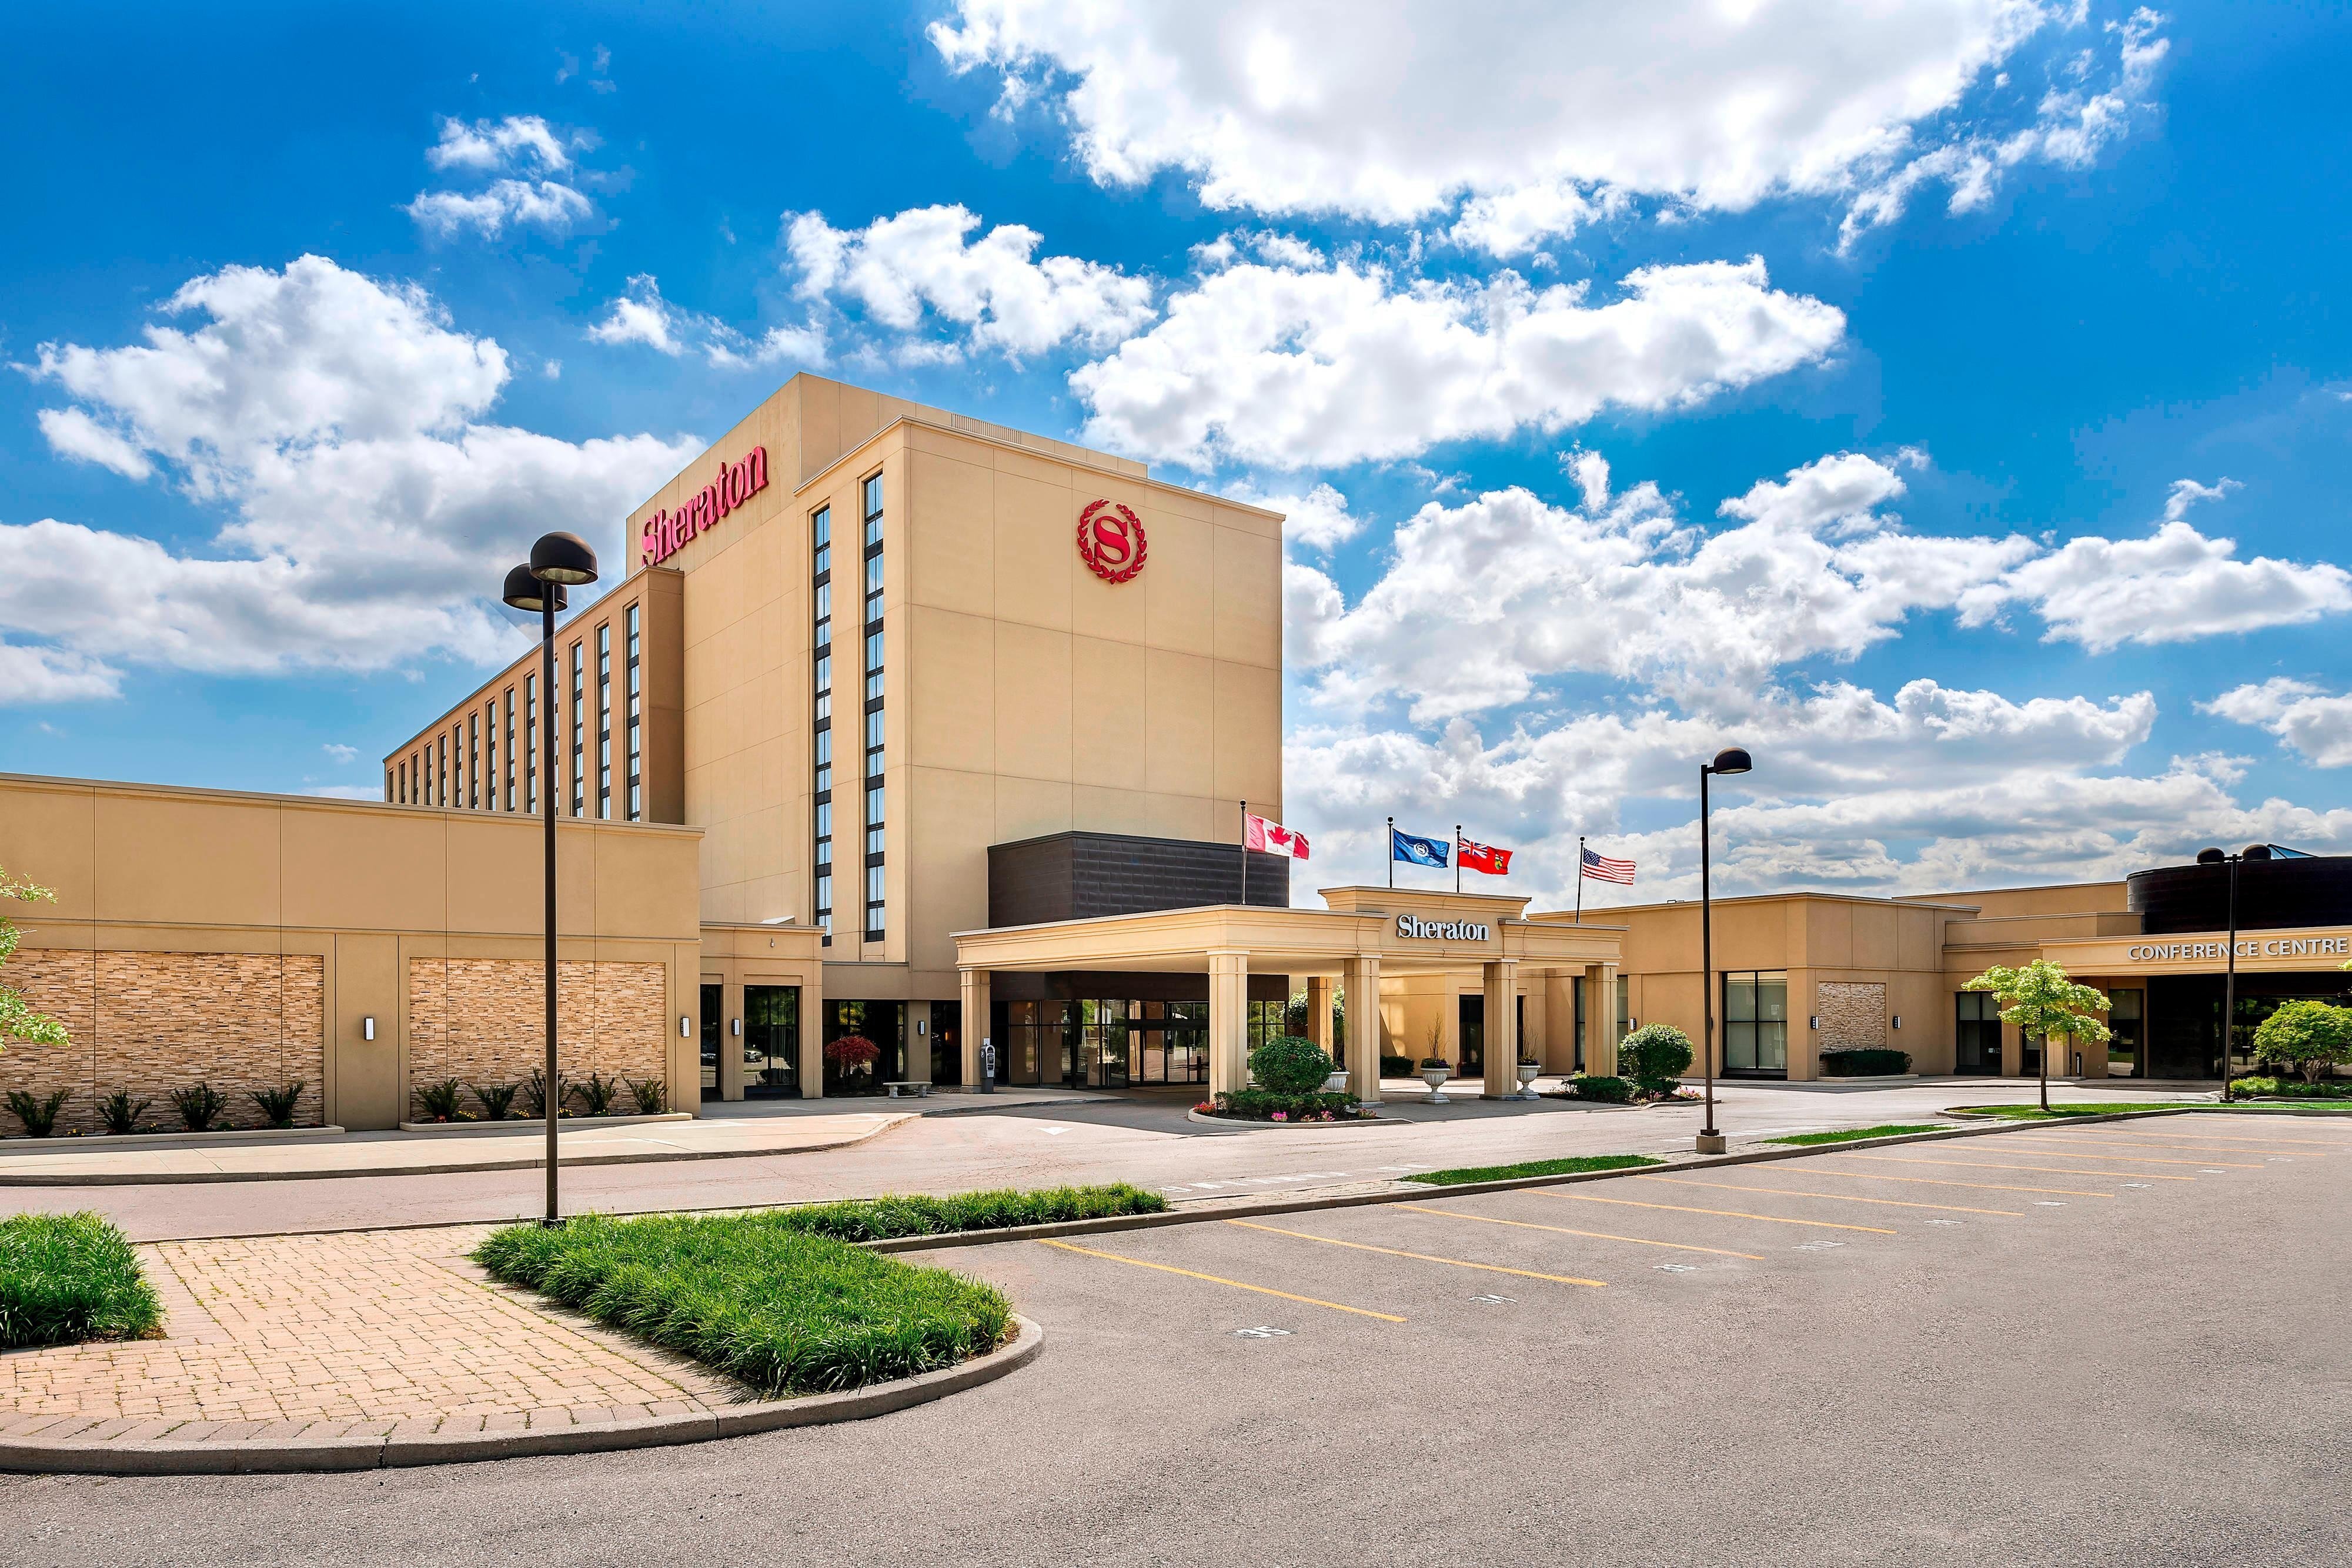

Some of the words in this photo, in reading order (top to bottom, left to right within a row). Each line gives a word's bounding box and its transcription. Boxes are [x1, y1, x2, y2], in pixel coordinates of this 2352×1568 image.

[642, 446, 769, 566] Sheraton
[1093, 516, 1131, 564] S
[1396, 914, 1490, 941] Sheraton
[2127, 941, 2260, 961] CONFERENCE
[2264, 937, 2349, 957] CENTRE
